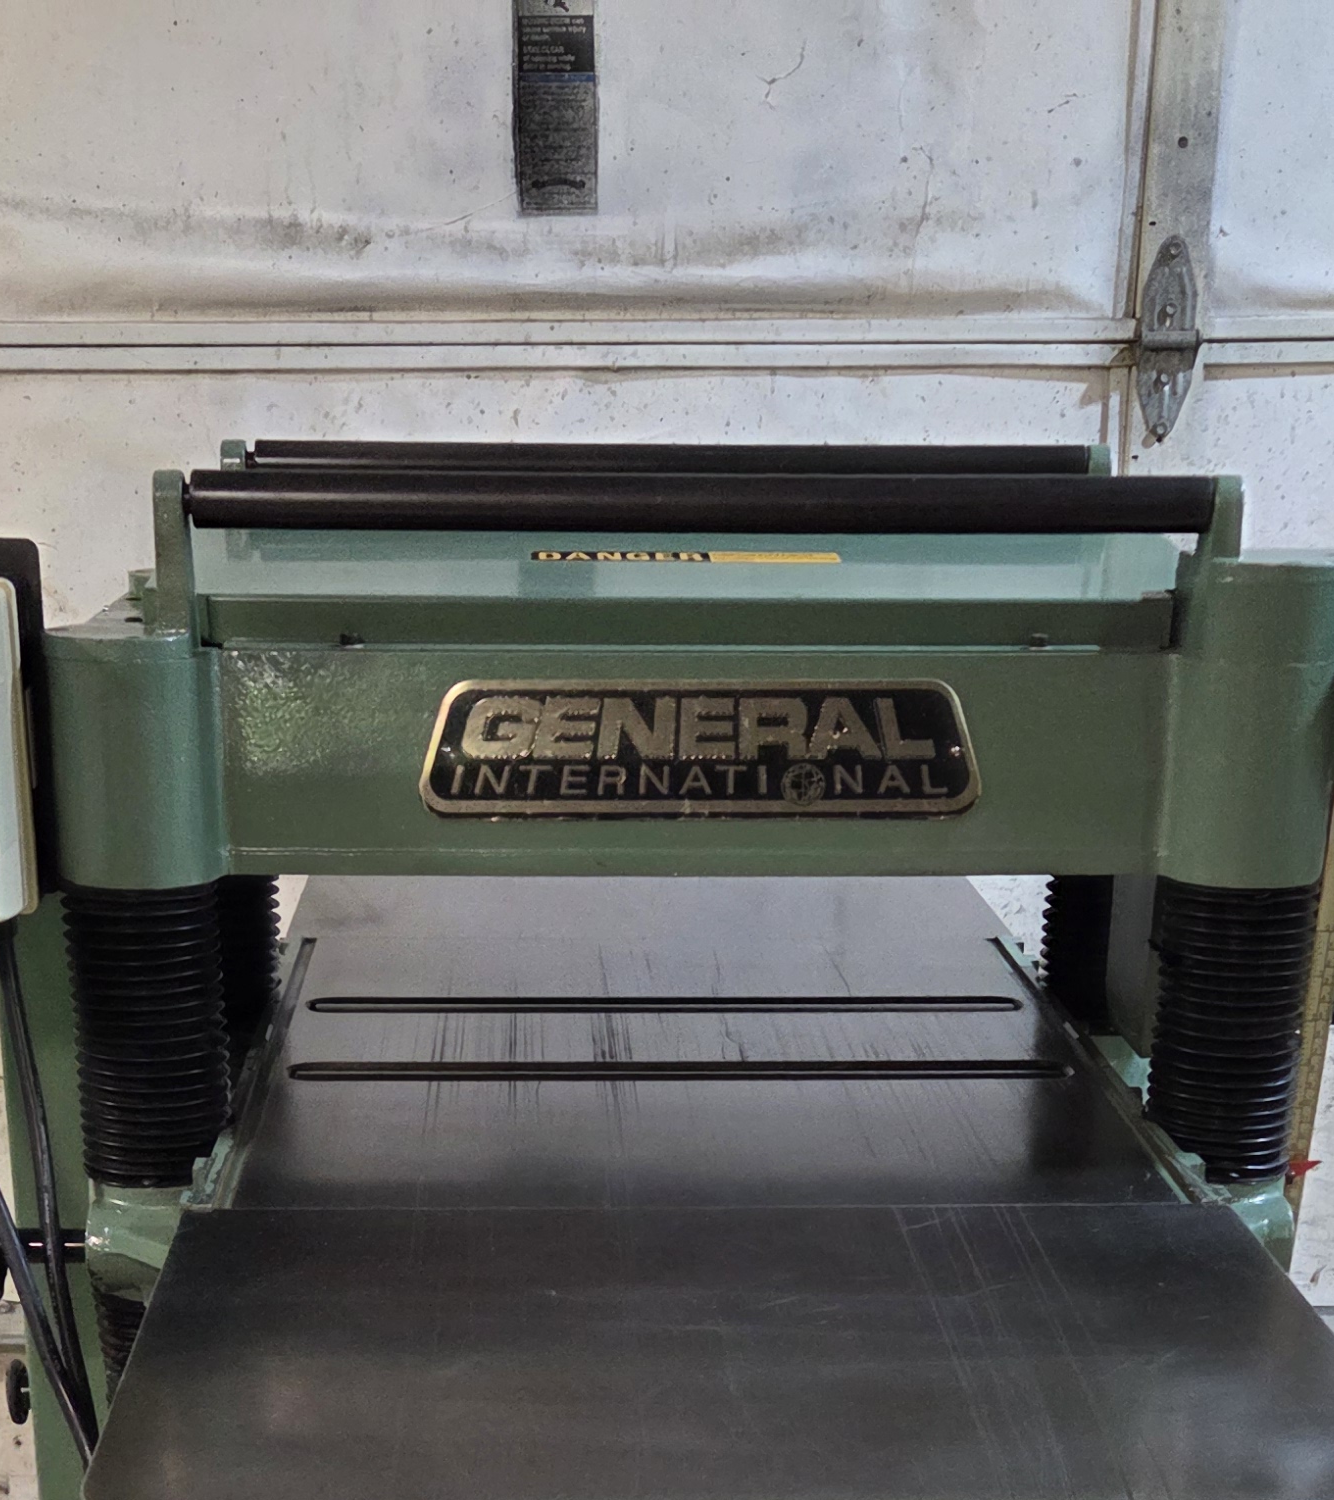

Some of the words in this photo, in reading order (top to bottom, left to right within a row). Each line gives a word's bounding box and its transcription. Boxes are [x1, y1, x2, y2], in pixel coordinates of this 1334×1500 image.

[537, 551, 704, 562] DANGER
[460, 697, 936, 761] GENERAL
[450, 763, 949, 804] INTERNATIONAL
